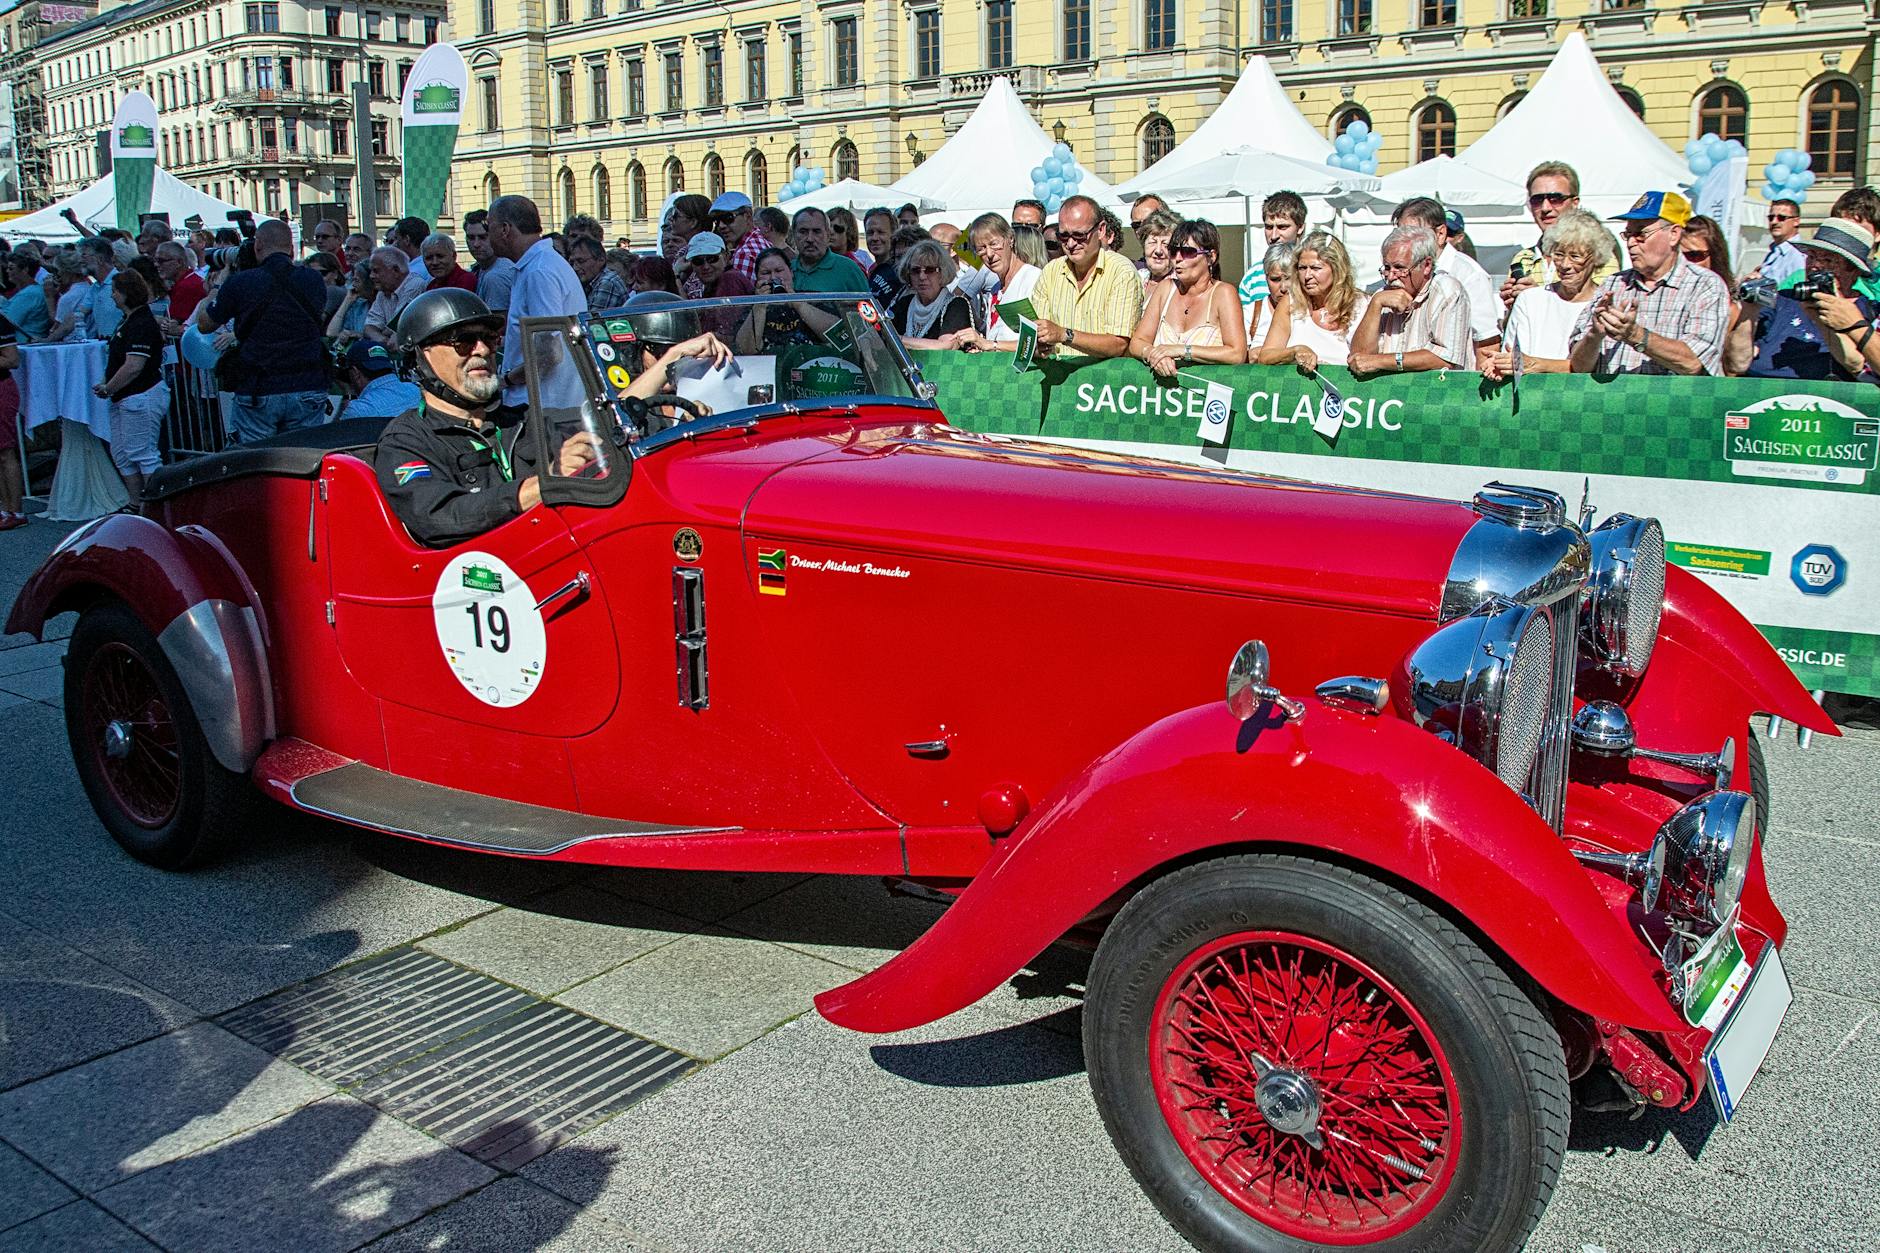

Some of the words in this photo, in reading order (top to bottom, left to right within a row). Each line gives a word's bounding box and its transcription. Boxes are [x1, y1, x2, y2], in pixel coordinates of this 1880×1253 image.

[817, 372, 839, 383] 2011
[1076, 383, 1206, 418] SACHSE
[1246, 391, 1404, 431] CLASIC
[1780, 418, 1822, 433] 2011
[1734, 435, 1803, 457] SACHSEN
[1806, 443, 1869, 461] CLASSIC
[789, 555, 823, 570] Driver:
[821, 559, 861, 573] Michael
[862, 562, 911, 578] Bernecker
[1690, 556, 1744, 572] Sachsenring
[465, 602, 511, 654] 19
